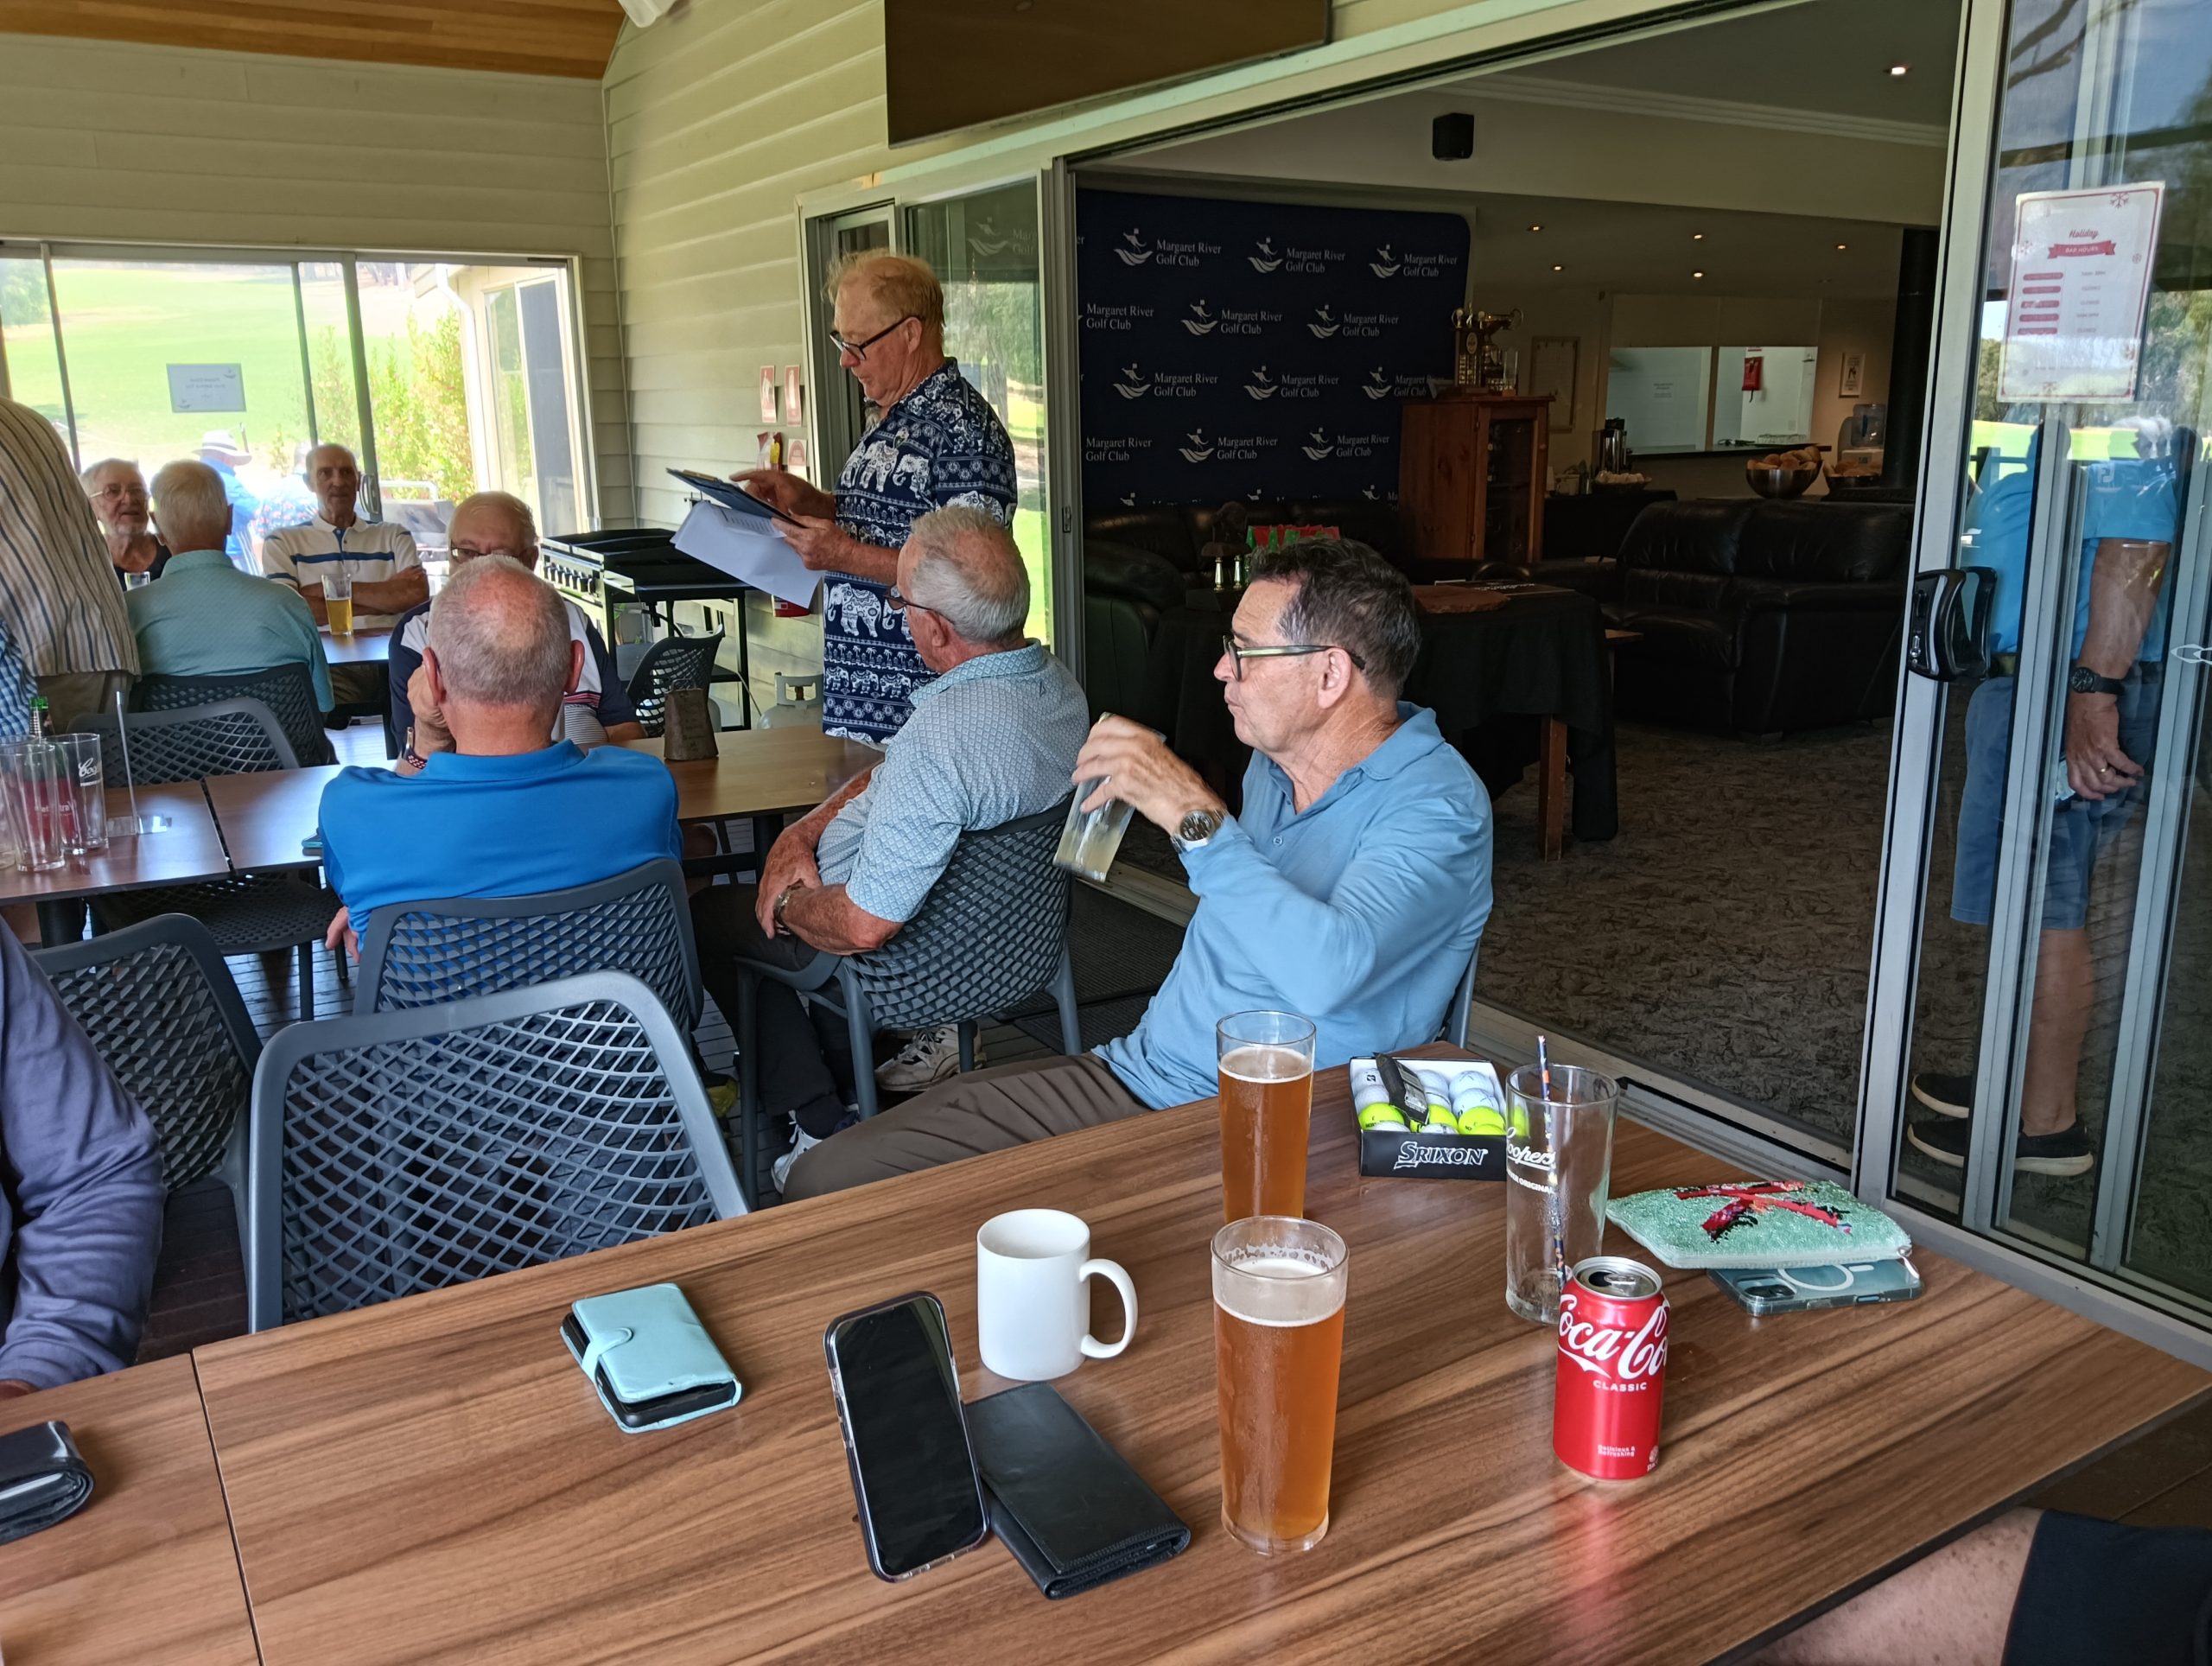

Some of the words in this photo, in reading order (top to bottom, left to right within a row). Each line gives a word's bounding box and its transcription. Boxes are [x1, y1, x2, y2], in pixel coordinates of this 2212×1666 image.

[2069, 229, 2100, 240] Holiday
[1156, 239, 1195, 254] Margaret
[1198, 242, 1222, 254] River
[1156, 253, 1177, 265] Golf
[1179, 255, 1200, 266] Club
[1286, 248, 1321, 261] Margaret
[1324, 249, 1345, 261] River
[1404, 253, 1436, 266] Margaret
[1438, 254, 1458, 264] River
[1286, 261, 1304, 272] Golf
[1306, 262, 1325, 273] Club
[1403, 266, 1421, 277] Golf
[1421, 266, 1440, 277] Club
[1086, 304, 1127, 317] Margaret
[1130, 305, 1154, 317] River
[1221, 309, 1257, 322] Margaret
[1261, 311, 1283, 321] River
[1086, 318, 1108, 329] Golf
[1109, 319, 1131, 330] Club
[1344, 313, 1376, 327] Margaret
[1379, 314, 1399, 325] River
[1221, 323, 1241, 334] Golf
[1242, 324, 1262, 334] Club
[1343, 327, 1361, 337] Golf
[1362, 327, 1380, 337] Club
[1154, 373, 1192, 385] Margaret
[1195, 373, 1218, 385] River
[1282, 374, 1316, 387] Margaret
[1319, 374, 1339, 385] River
[1395, 375, 1425, 387] Margaret
[1154, 386, 1175, 397] Golf
[1176, 386, 1197, 397] Club
[1281, 387, 1299, 397] Golf
[1300, 387, 1319, 397] Club
[1394, 386, 1409, 397] Golf
[1411, 387, 1427, 397] Club
[1086, 437, 1125, 450] Margaret
[1128, 437, 1152, 448] River
[1217, 437, 1254, 448] Margaret
[1256, 436, 1278, 447] River
[1337, 435, 1369, 447] Margaret
[1371, 434, 1389, 444] River
[1085, 451, 1107, 461] Golf
[1108, 451, 1130, 461] Club
[1217, 449, 1236, 460] Golf
[1237, 449, 1258, 460] Club
[1337, 447, 1353, 457] Golf
[1355, 447, 1372, 457] Club
[1394, 1141, 1489, 1170] SRIXON
[1592, 1379, 1647, 1392] CLASSIC
